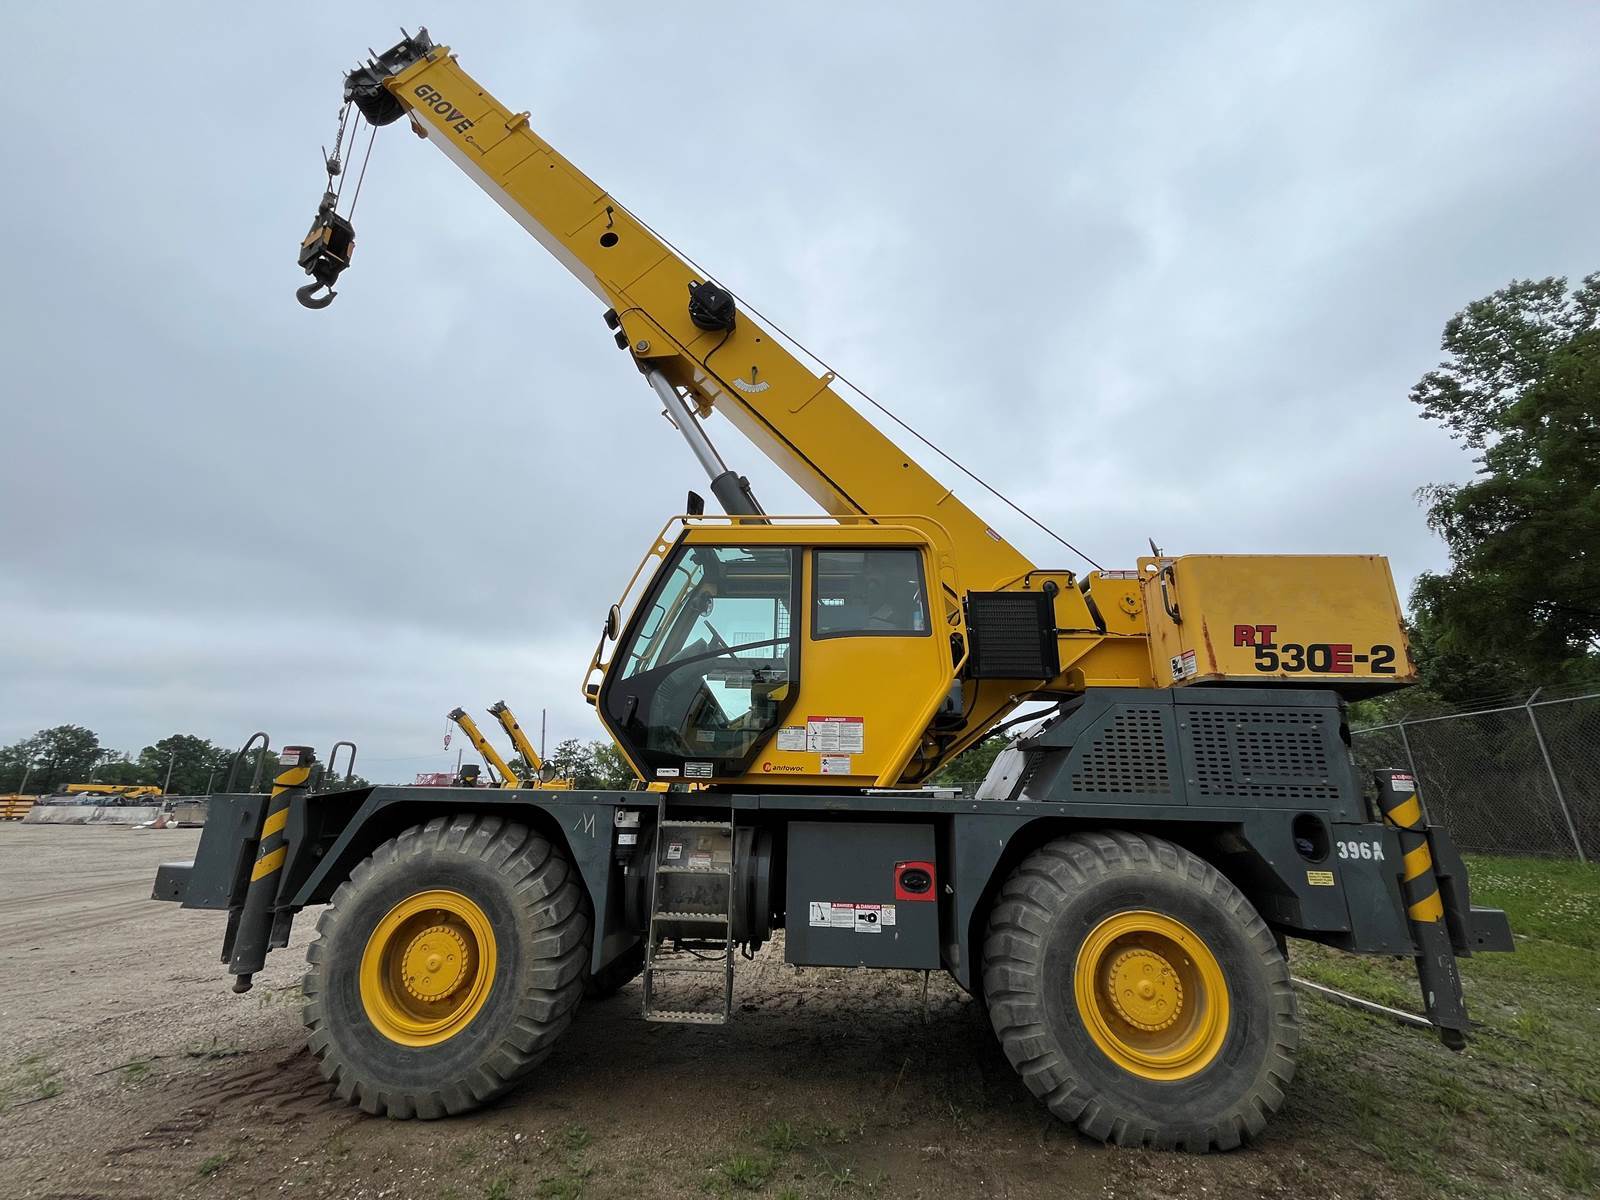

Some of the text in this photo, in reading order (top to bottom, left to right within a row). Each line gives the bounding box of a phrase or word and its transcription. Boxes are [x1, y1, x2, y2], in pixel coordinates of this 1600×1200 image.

[414, 84, 475, 134] GROVE
[1233, 625, 1277, 647] RT
[1255, 643, 1396, 673] 530E-2
[1336, 841, 1385, 861] 396A
